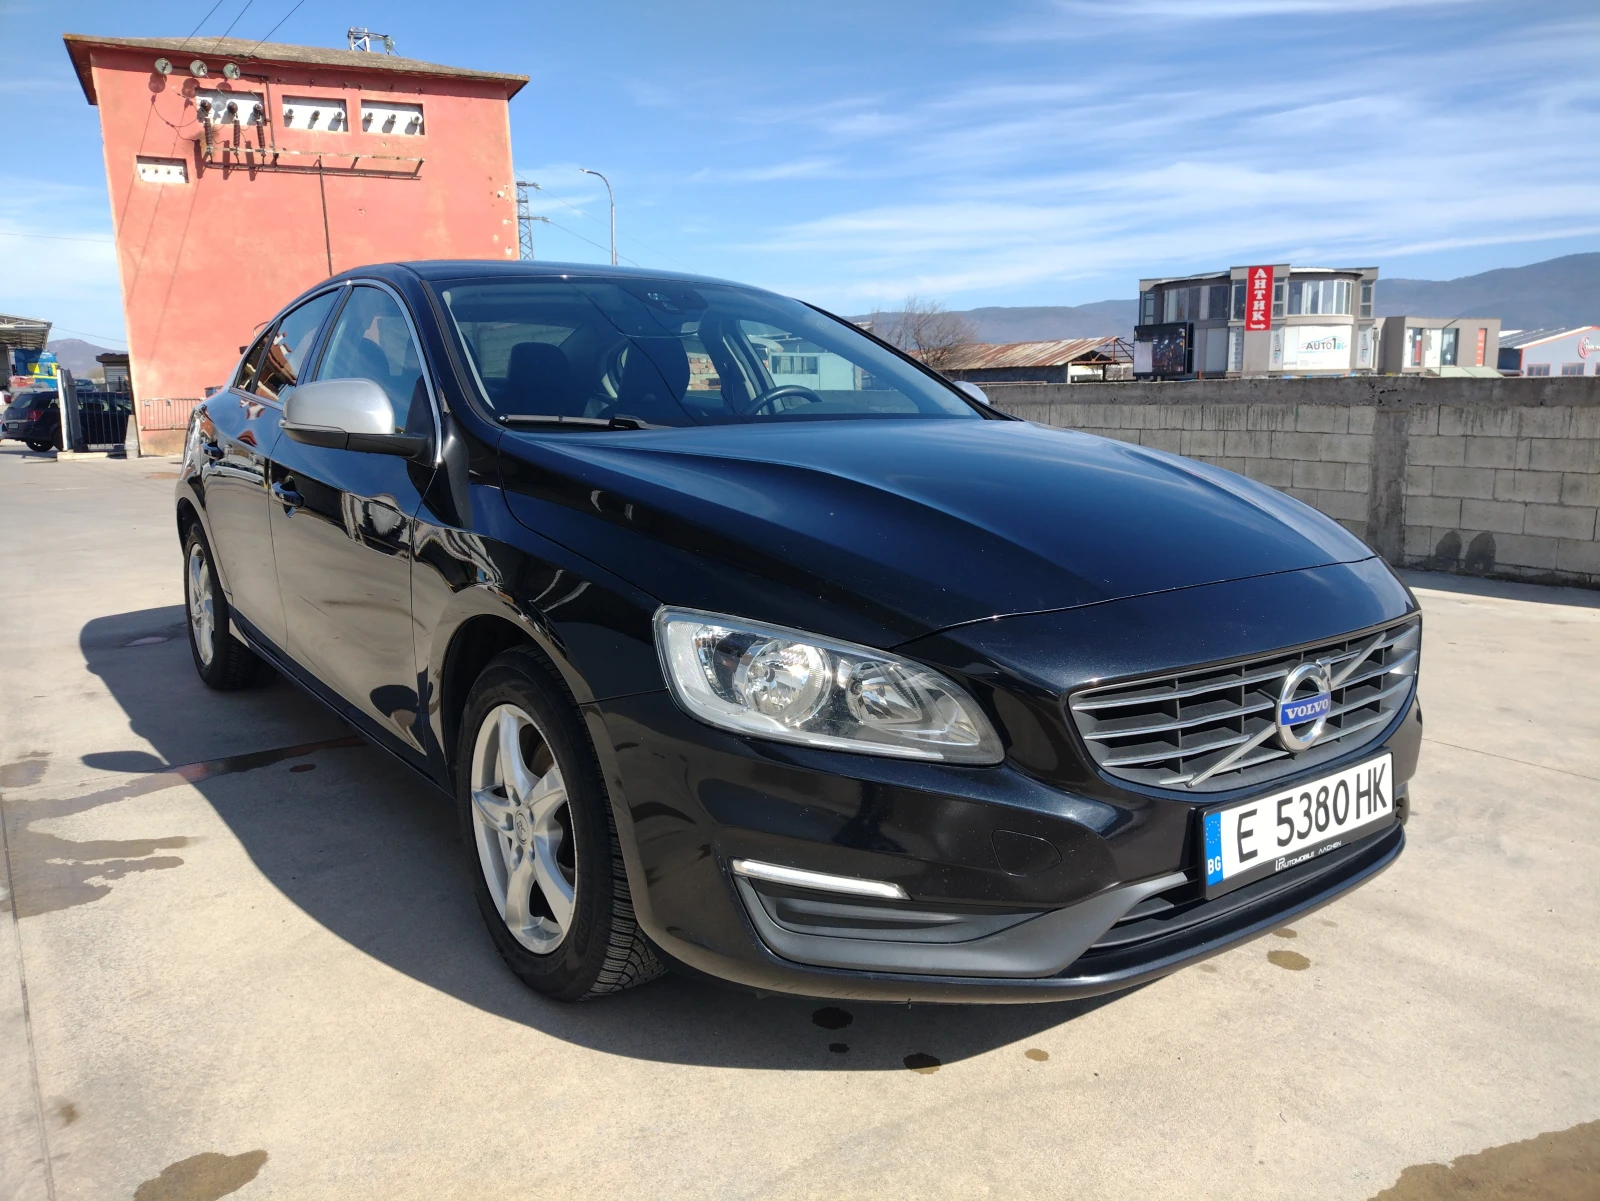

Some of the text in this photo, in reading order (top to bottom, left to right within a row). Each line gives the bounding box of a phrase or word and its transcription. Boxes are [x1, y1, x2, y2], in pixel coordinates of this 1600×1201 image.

[1252, 268, 1268, 321] АНТИК
[1285, 698, 1329, 720] VOLVO
[1237, 763, 1387, 863] E 5380 HK
[1318, 841, 1342, 855] AACHEN
[1208, 856, 1222, 874] BG
